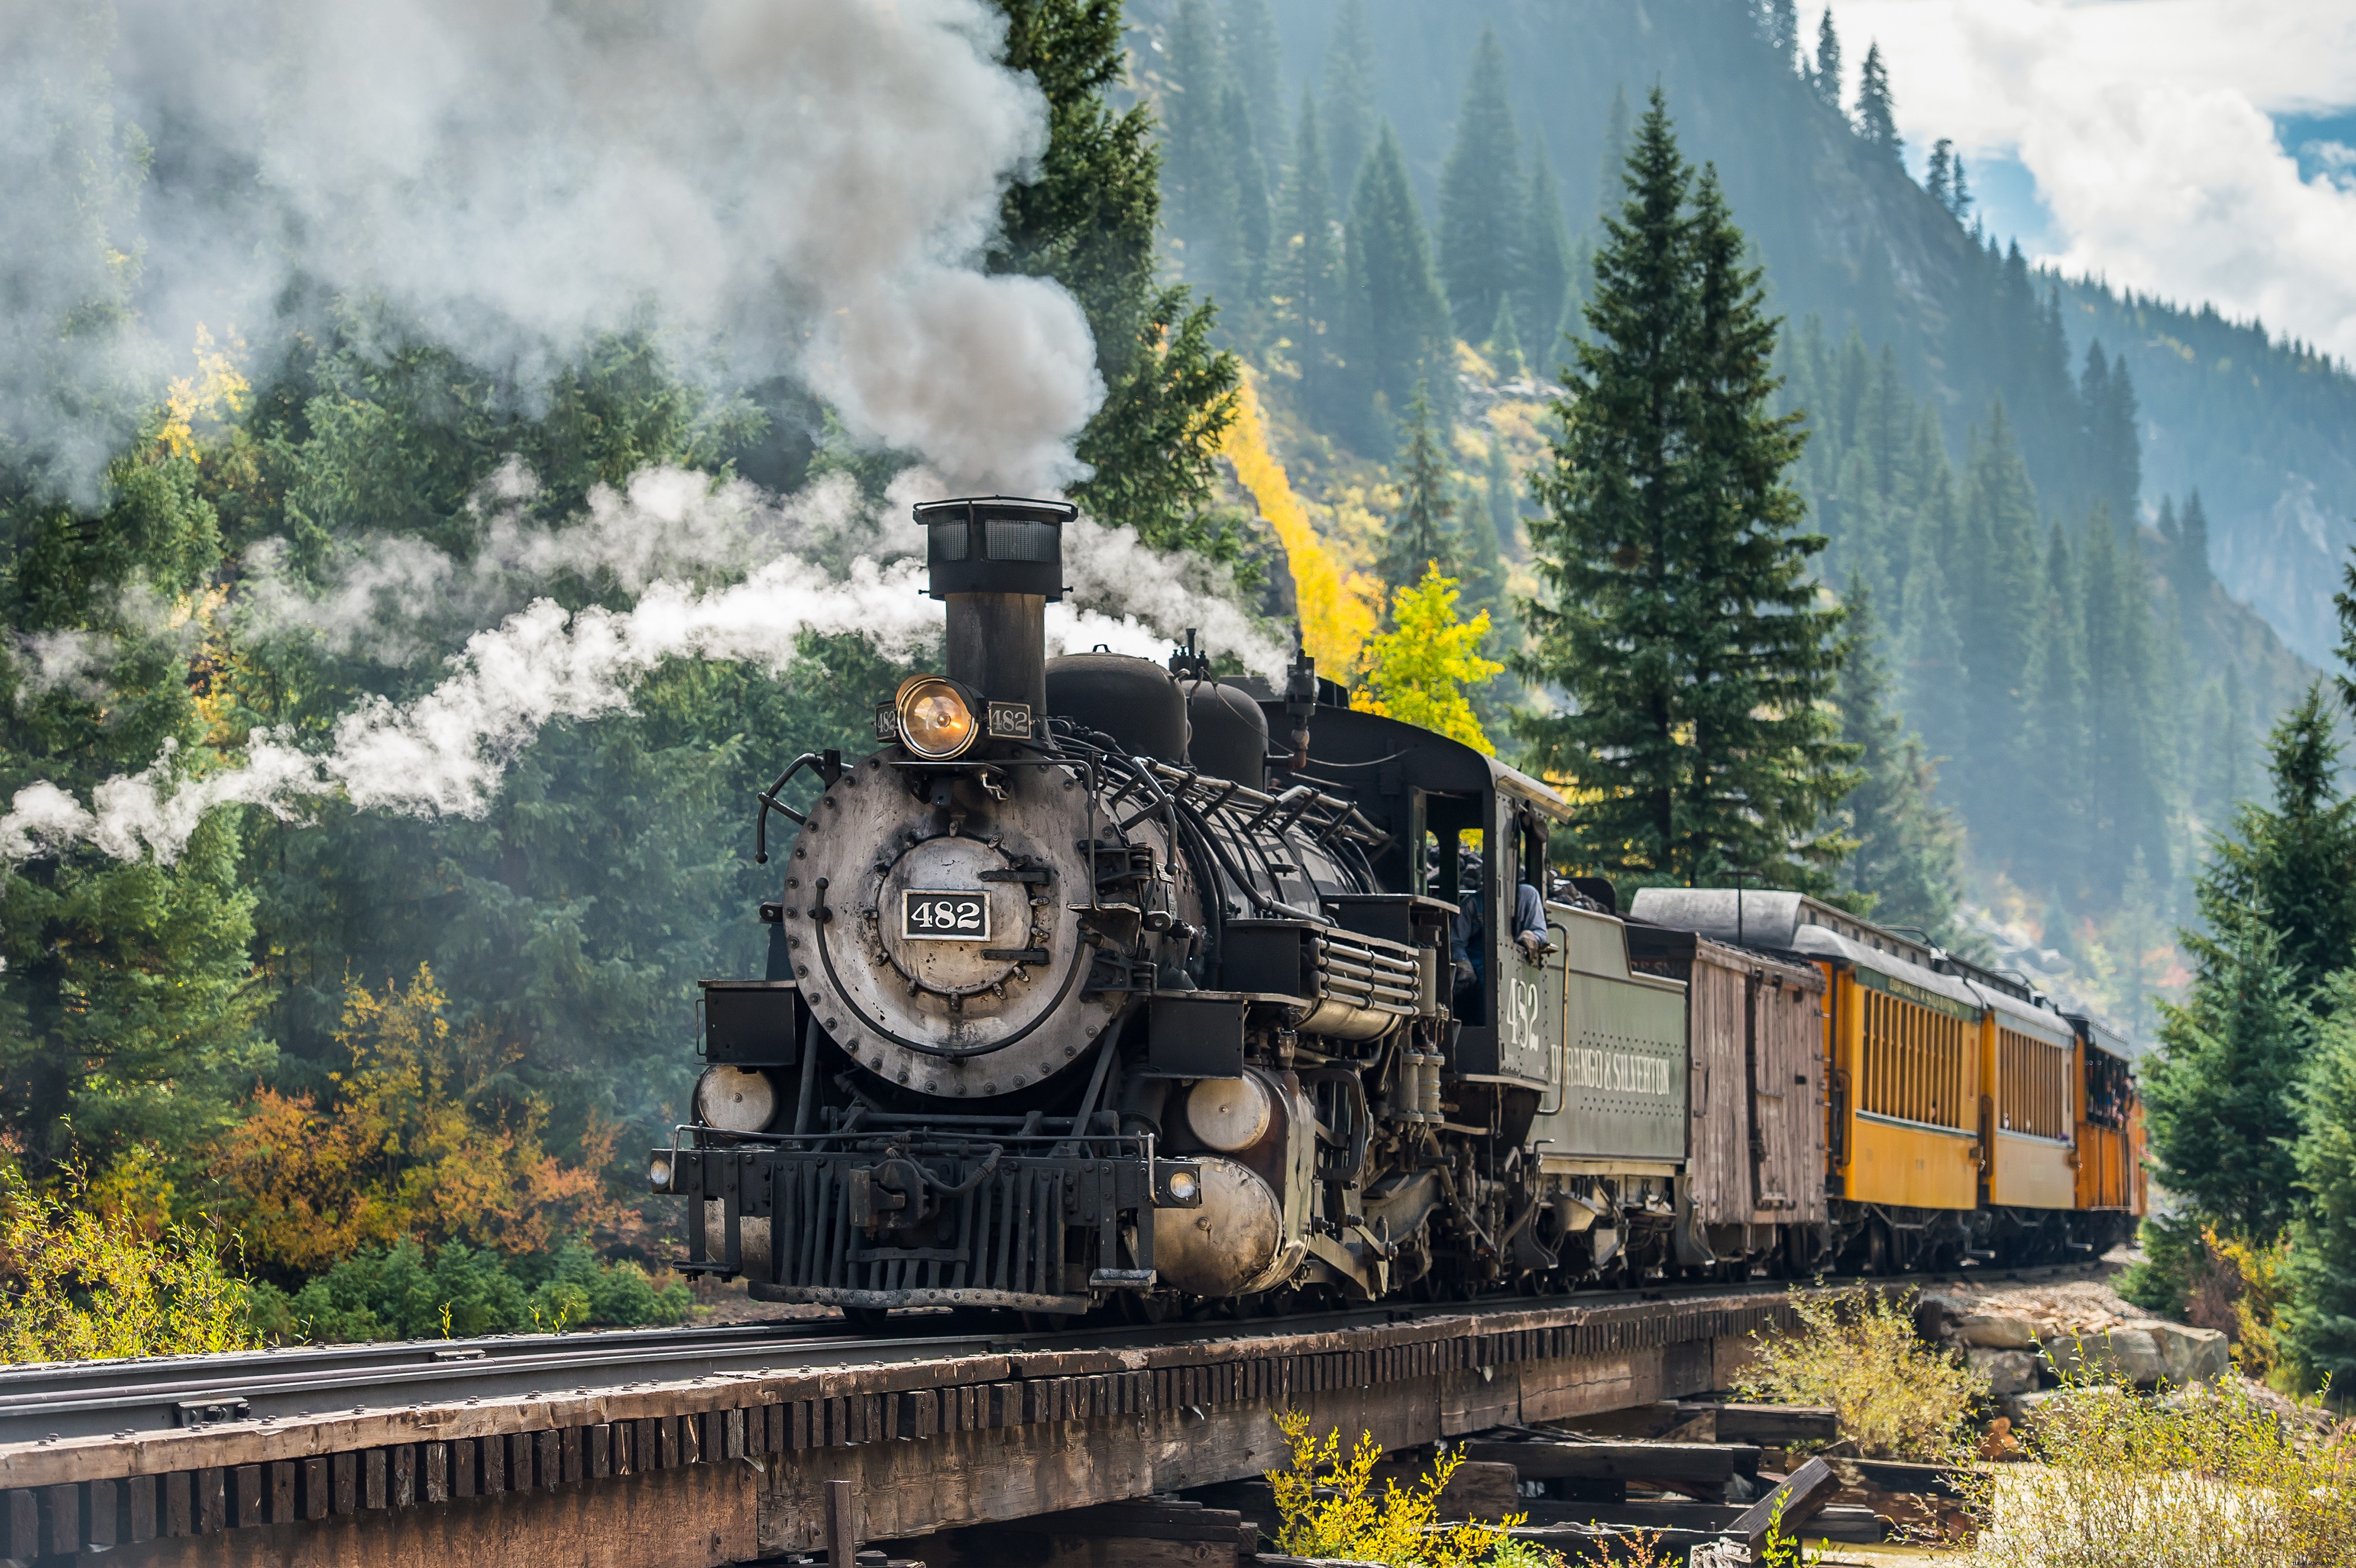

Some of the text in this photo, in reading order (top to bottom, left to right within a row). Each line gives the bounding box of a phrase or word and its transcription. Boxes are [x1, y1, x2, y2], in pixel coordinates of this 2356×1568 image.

[877, 710, 896, 733] 482
[991, 710, 1028, 733] 482
[910, 900, 981, 930] 482
[1506, 977, 1539, 1052] 482
[1604, 1051, 1613, 1092] &
[1613, 1052, 1670, 1096] SILVERTON
